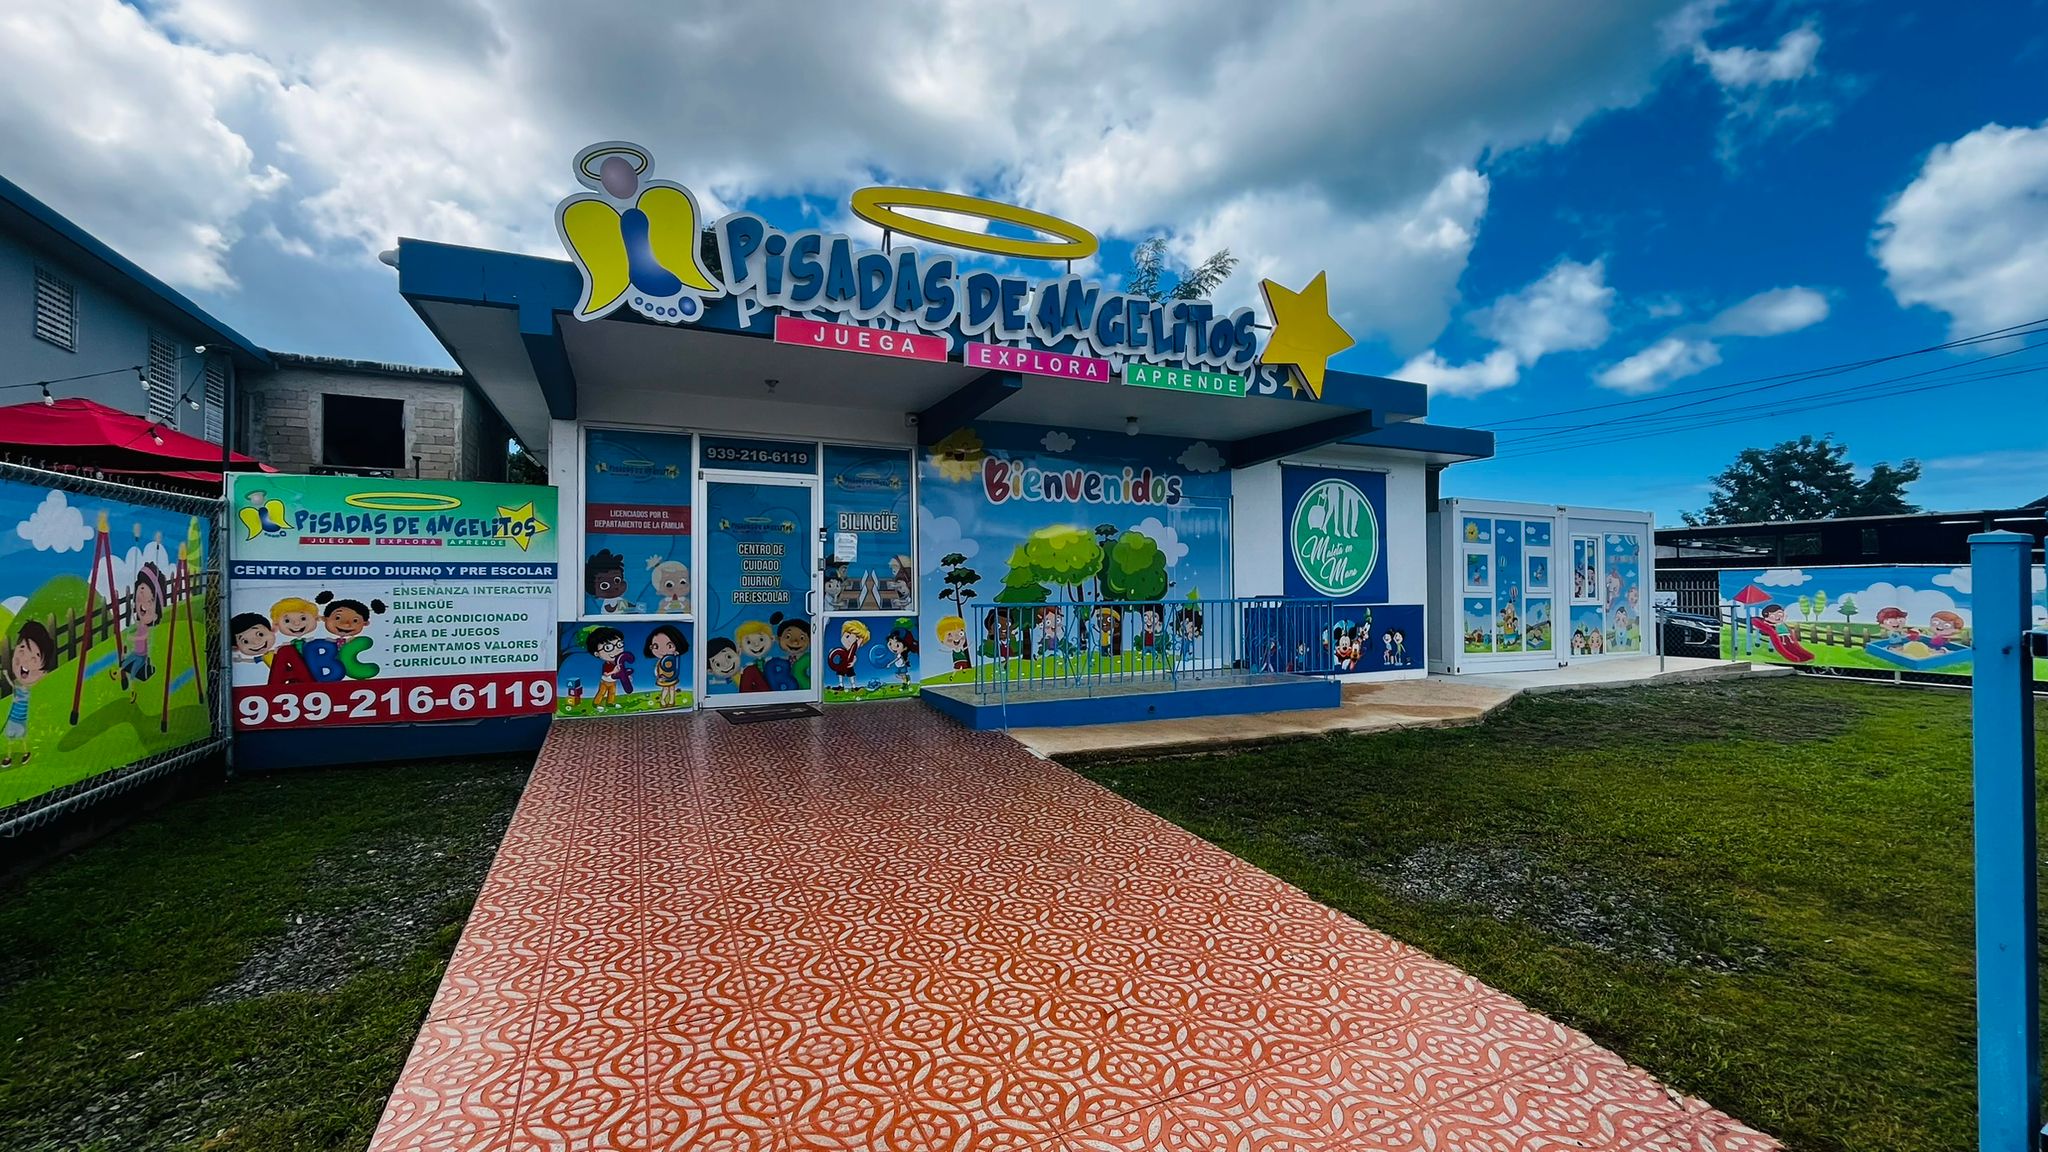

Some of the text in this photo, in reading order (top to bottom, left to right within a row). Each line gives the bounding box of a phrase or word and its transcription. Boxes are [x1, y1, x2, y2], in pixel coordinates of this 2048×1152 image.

[967, 273, 1027, 331] DE
[814, 326, 915, 354] JUEGA
[980, 348, 1098, 377] EXPLORA
[1135, 368, 1238, 393] APRENDE
[707, 447, 808, 464] 939-216-6119
[983, 456, 1181, 506] Bienvenidos
[610, 509, 669, 519] LICENCIADOS POR EL
[393, 516, 420, 535] DE
[594, 520, 684, 530] DEPARTAMENTO DE LA FAMILIA
[840, 512, 897, 531] BILINGÜE
[738, 543, 784, 555] CENTRO DE
[234, 565, 553, 576] CENTRO DE CUIDO DIURNO Y PRE ESCOLAR
[743, 560, 779, 571] CUIDADO
[742, 576, 781, 586] DIURNO Y
[473, 586, 552, 595] INTERACTIVA
[733, 591, 788, 603] PRE ESCOLAR
[393, 613, 529, 624] AIRE ACONDICIONADO
[393, 627, 500, 638] ÁREA DE JUEGOS
[393, 640, 539, 653] FOMENTAMOS VALORES
[393, 653, 539, 668] CURRÍCULO INTEGRADO
[238, 679, 553, 726] 939-216-6119
